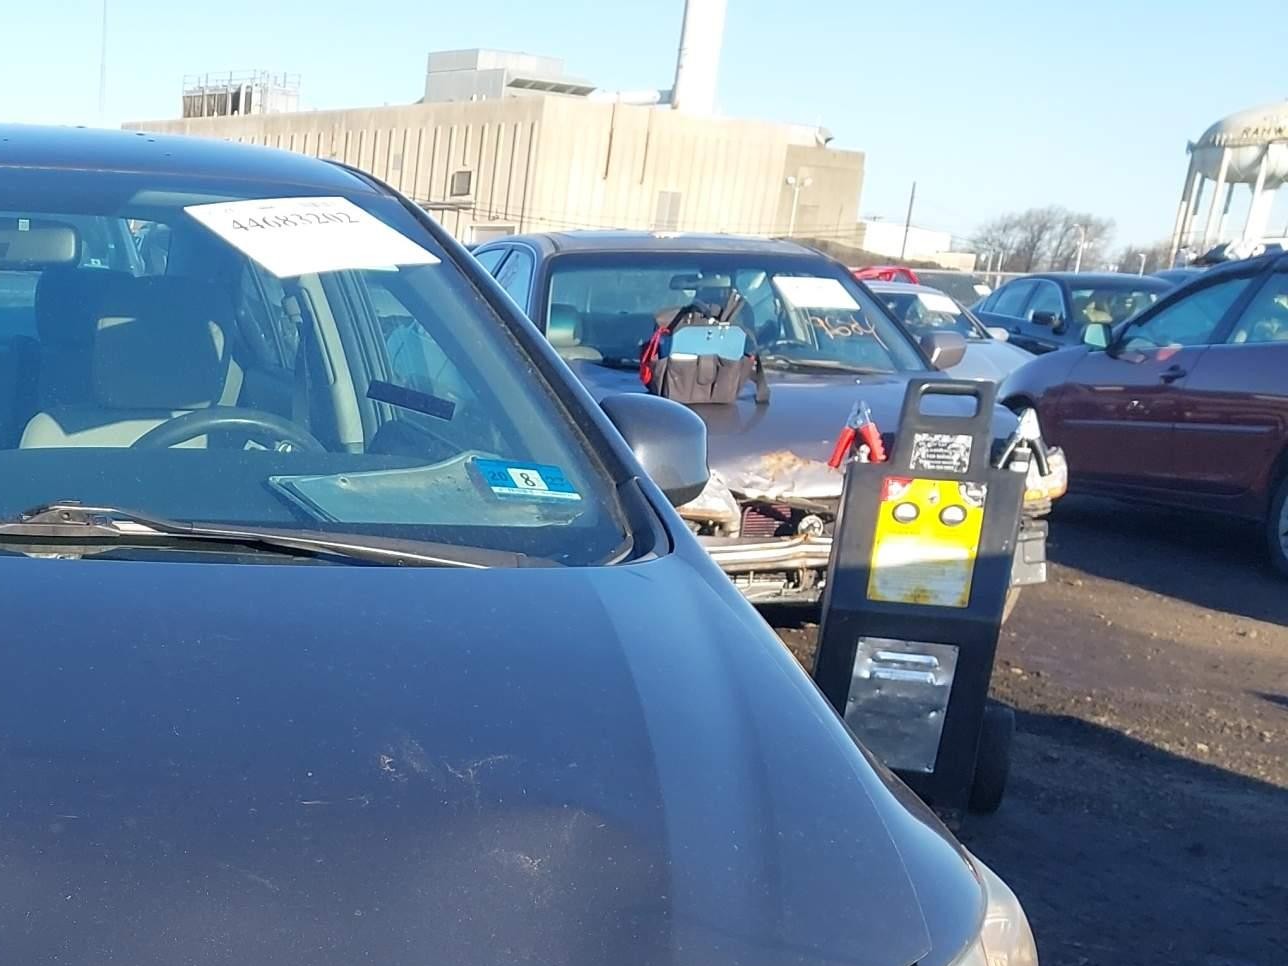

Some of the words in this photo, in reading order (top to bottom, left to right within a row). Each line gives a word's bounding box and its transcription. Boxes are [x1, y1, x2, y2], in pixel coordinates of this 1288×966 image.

[232, 212, 360, 231] 44683202
[488, 471, 508, 481] 20
[519, 472, 537, 488] 8
